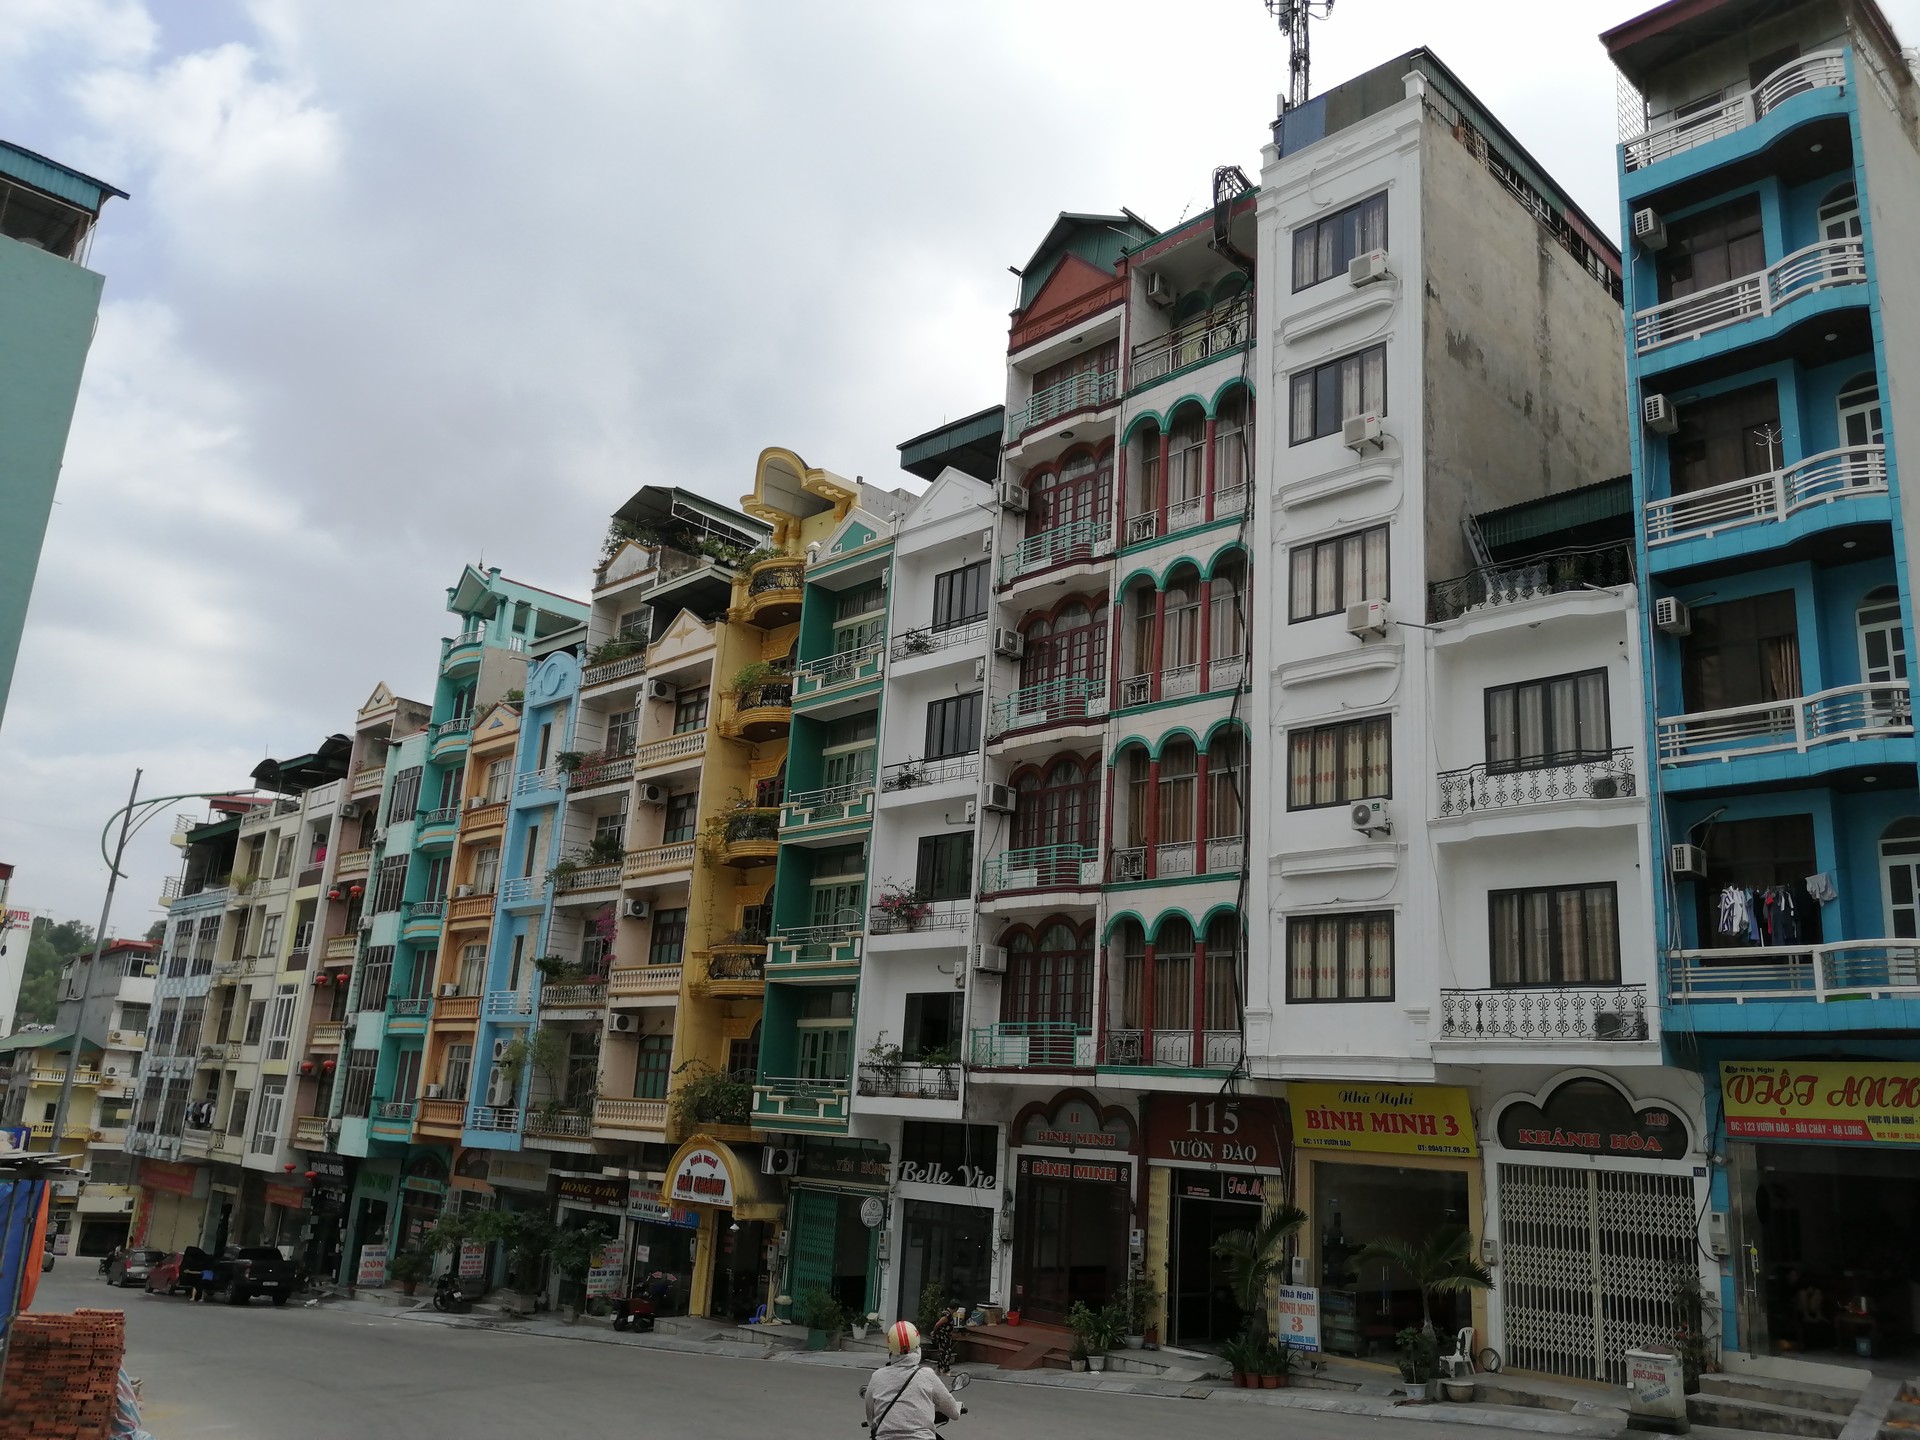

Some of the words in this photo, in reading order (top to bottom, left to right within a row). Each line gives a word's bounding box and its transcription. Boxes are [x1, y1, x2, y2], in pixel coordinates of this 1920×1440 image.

[1338, 1091, 1370, 1104] Nhà
[1726, 1069, 1819, 1116] VIỆT
[1186, 1101, 1239, 1135] 115
[1305, 1105, 1365, 1133] BÌNH
[1369, 1112, 1438, 1136] MINH
[1442, 1114, 1460, 1137] 3
[1645, 1112, 1669, 1127] 119
[1743, 1121, 1755, 1132] 123
[1844, 1125, 1863, 1136] LONG
[1037, 1128, 1072, 1144] BÌNH
[1075, 1131, 1116, 1146] MINH
[1518, 1127, 1600, 1148] KHÁNH
[1609, 1131, 1663, 1152] HÒA
[1169, 1138, 1214, 1159] VƯỜN
[1222, 1139, 1257, 1163] ĐÀO
[899, 1160, 953, 1185] Belle
[957, 1165, 996, 1189] Vie
[1021, 1160, 1028, 1174] 2
[1032, 1159, 1071, 1178] BÌNH
[1073, 1165, 1118, 1182] MINH
[1120, 1168, 1128, 1182] 2
[1297, 1303, 1316, 1317] MINH
[1291, 1316, 1304, 1333] 3
